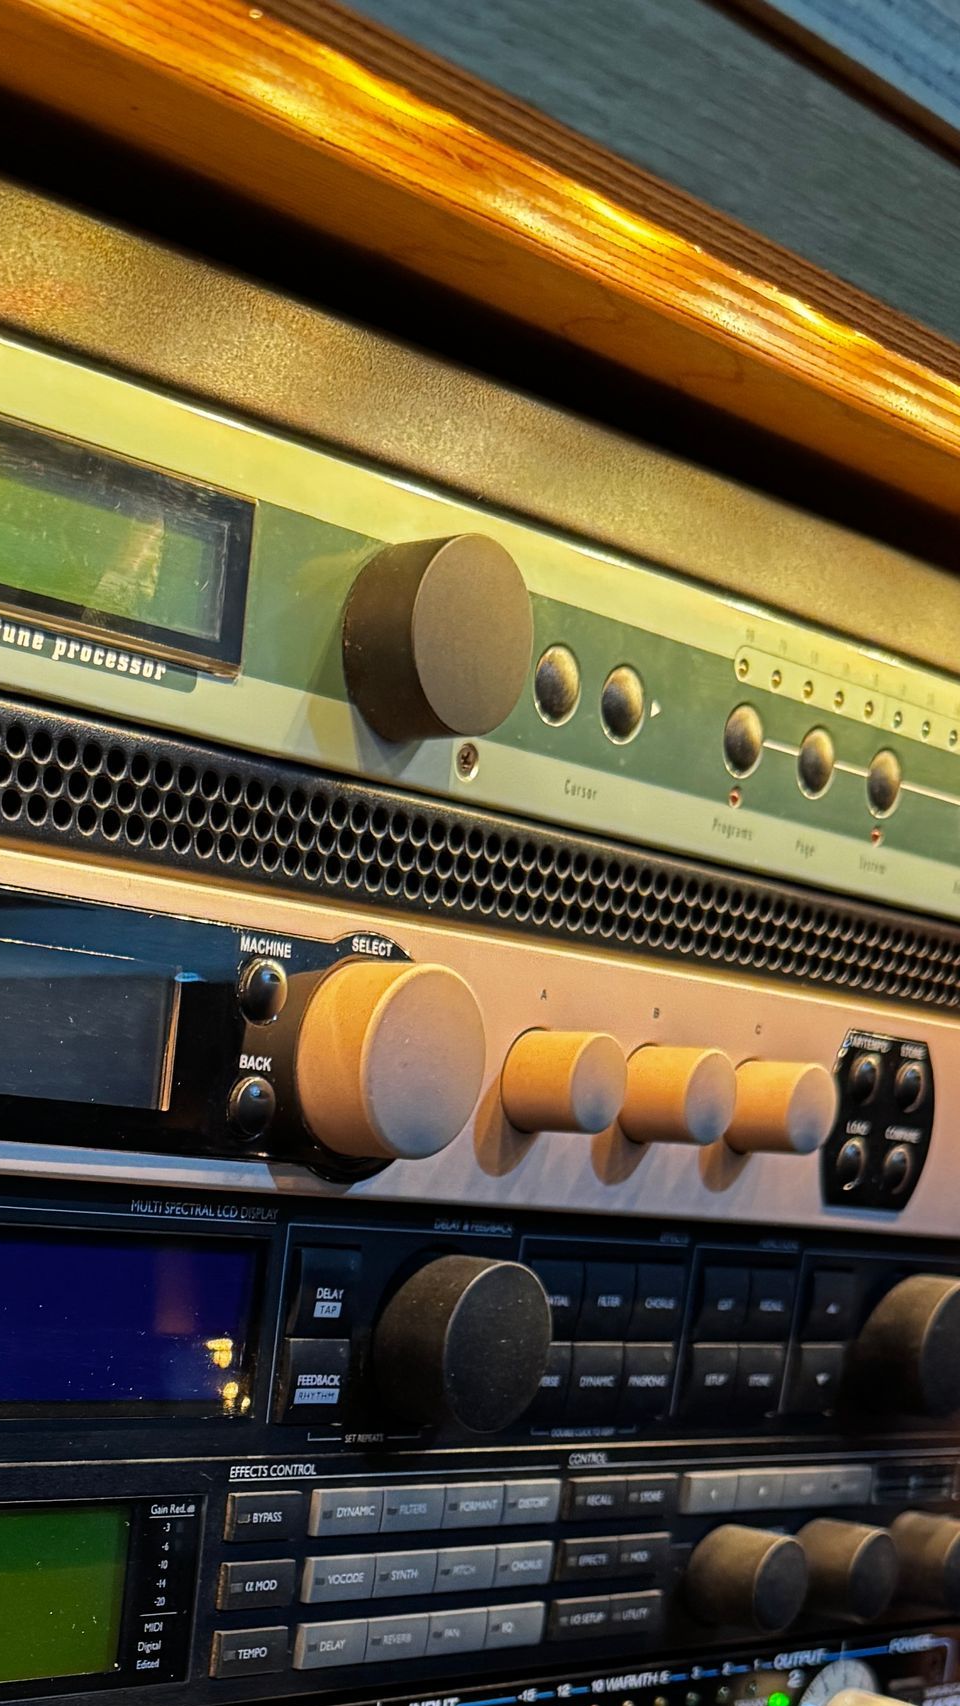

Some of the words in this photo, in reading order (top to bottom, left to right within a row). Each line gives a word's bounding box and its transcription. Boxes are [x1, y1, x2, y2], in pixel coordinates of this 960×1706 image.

[52, 634, 166, 682] processor
[564, 778, 597, 800] Cursor
[241, 935, 291, 958] MACHINE
[352, 936, 392, 957] SELECT
[239, 1054, 271, 1072] BACK
[131, 1200, 163, 1213] MULTI
[165, 1202, 214, 1217] SPECTRAL
[217, 1204, 238, 1218] LCD
[240, 1206, 279, 1221] DISPLAY
[317, 1288, 344, 1299] DELAY
[319, 1305, 337, 1315] TAP
[297, 1375, 340, 1386] FEEDBACK
[230, 1465, 270, 1479] EFFECTS
[272, 1464, 317, 1478] CONTROL
[151, 1505, 168, 1514] Gain
[336, 1505, 375, 1519] DYNAMIC
[252, 1511, 282, 1524] BYPASS
[144, 1622, 163, 1632] MIDI
[320, 1639, 345, 1652] DELAY
[238, 1647, 267, 1660] TEMPO
